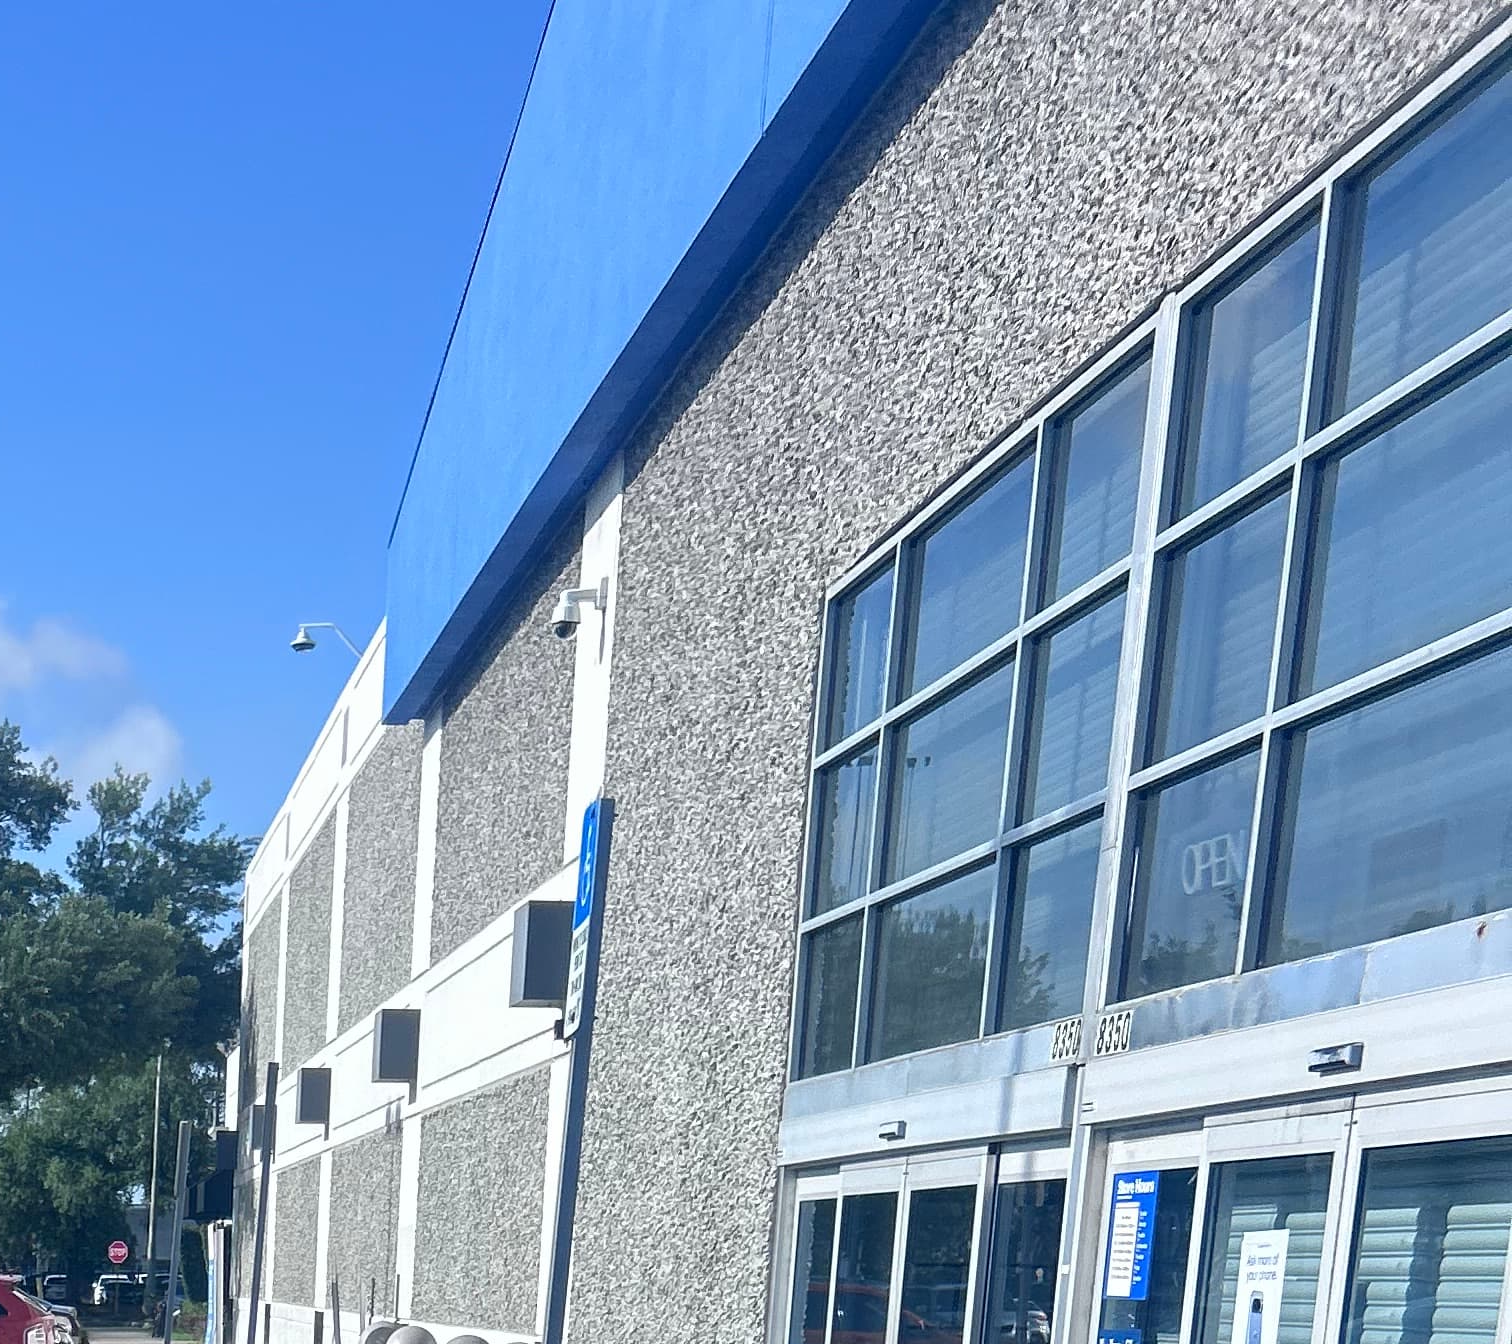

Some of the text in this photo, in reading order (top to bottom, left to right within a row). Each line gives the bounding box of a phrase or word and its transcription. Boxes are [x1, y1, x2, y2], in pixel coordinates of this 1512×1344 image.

[1052, 1019, 1082, 1060] 8350
[1096, 1012, 1131, 1055] 8350
[110, 1247, 127, 1257] STOP
